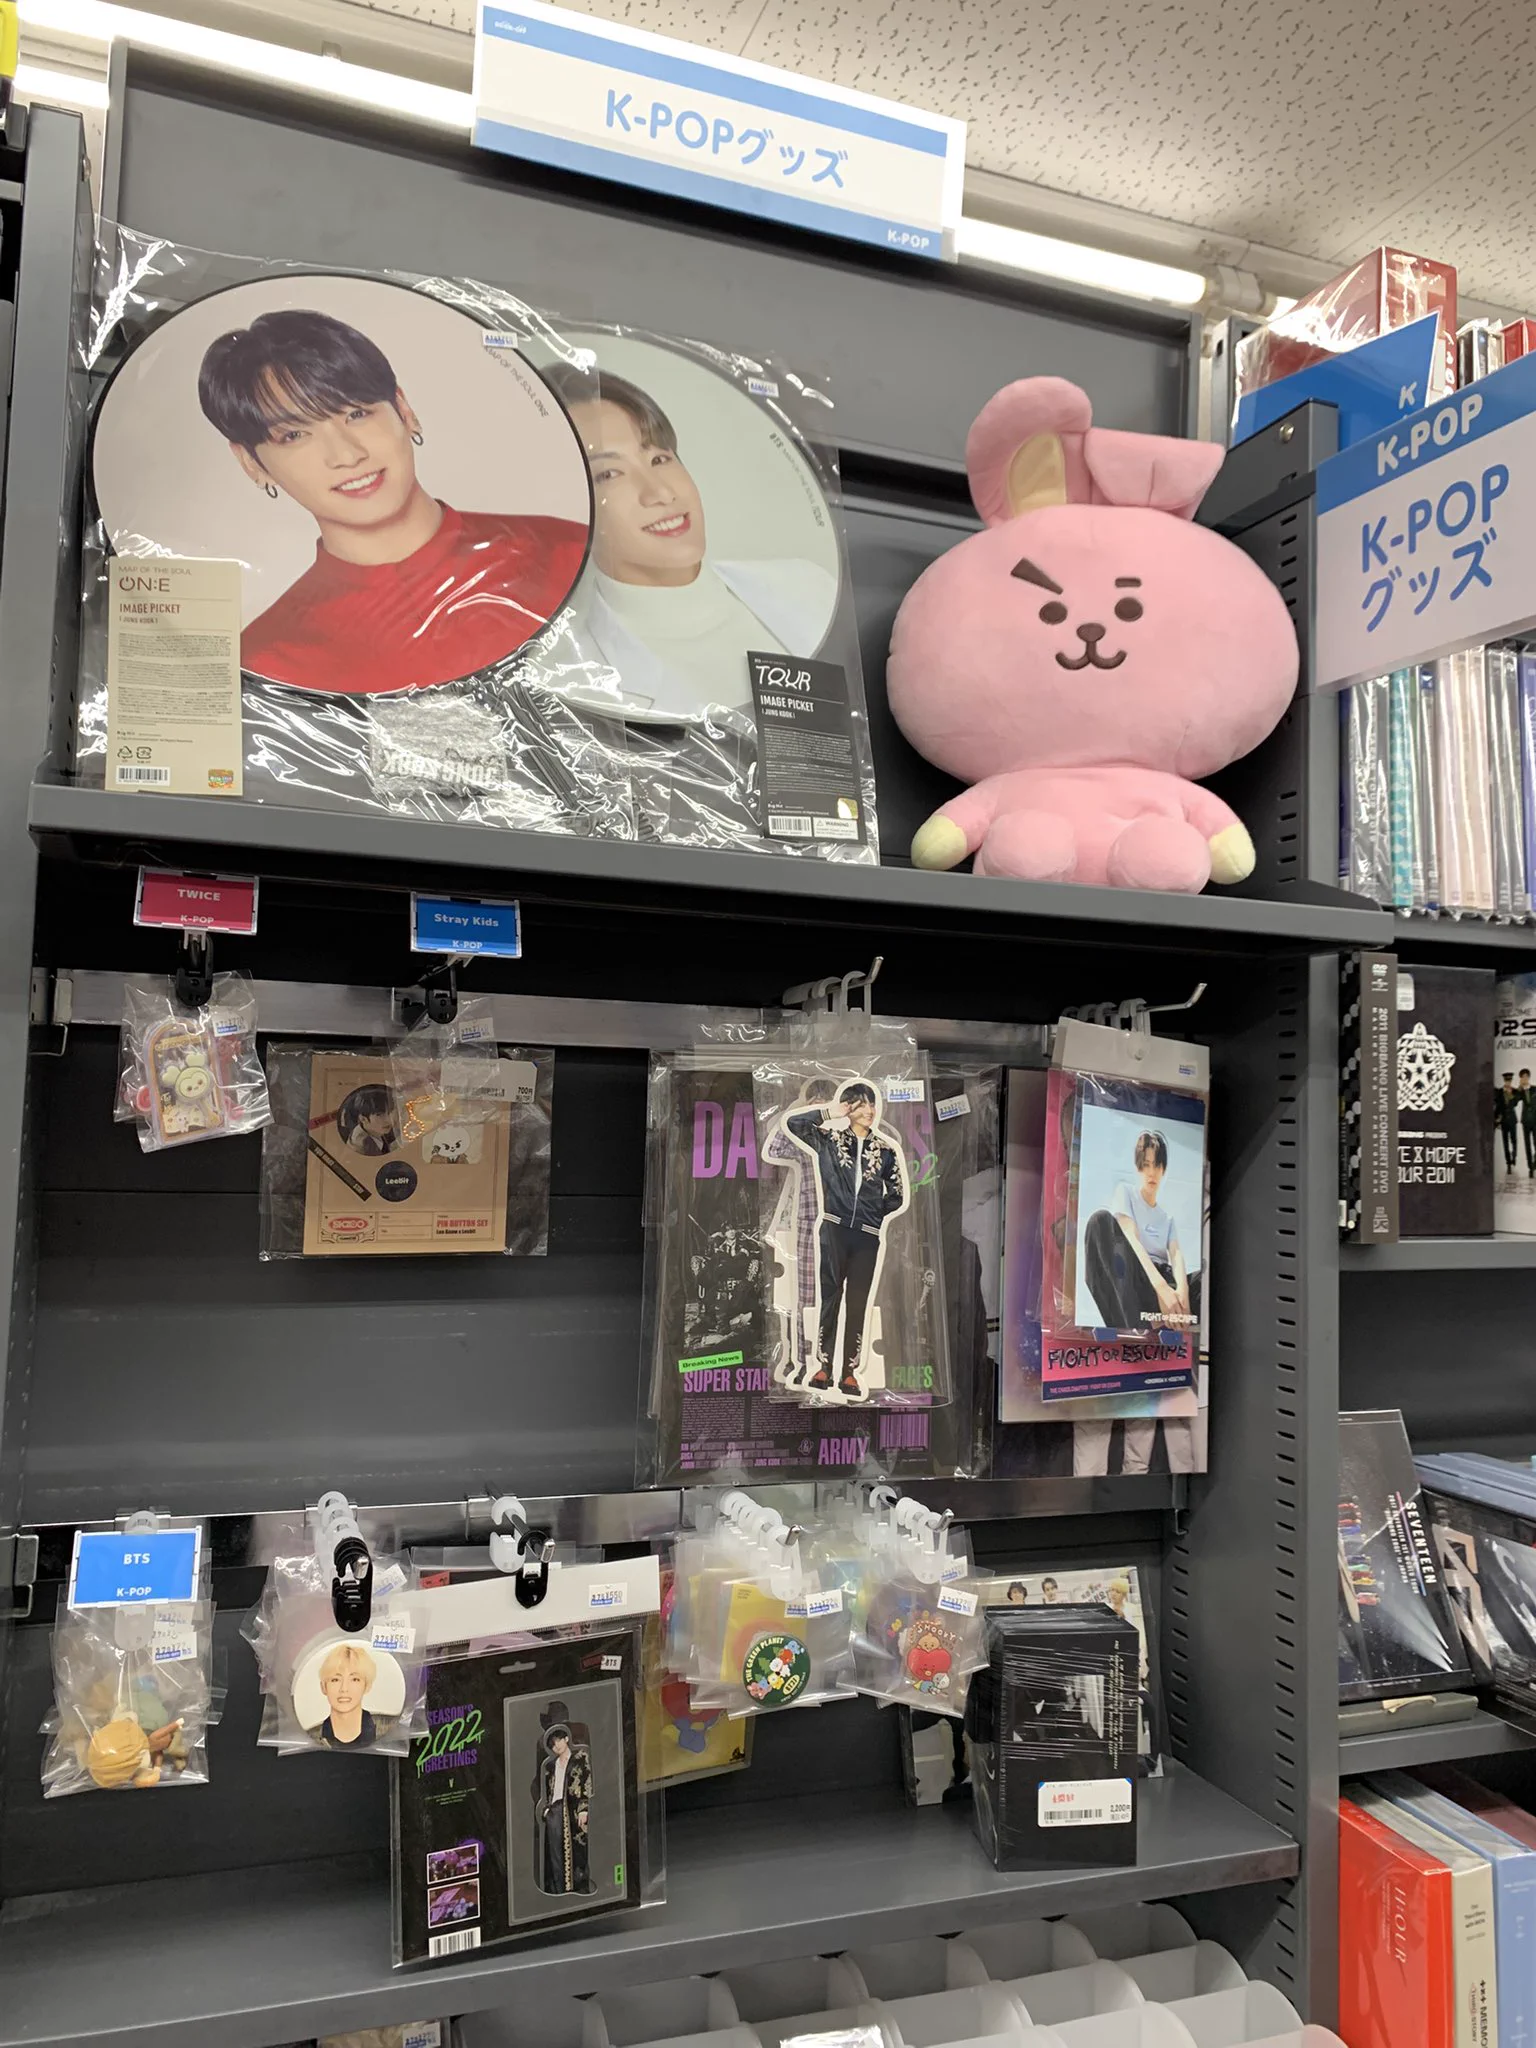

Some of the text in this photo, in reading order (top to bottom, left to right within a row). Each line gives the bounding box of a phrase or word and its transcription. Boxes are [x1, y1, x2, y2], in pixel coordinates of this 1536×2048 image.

[604, 89, 849, 189] K-POPグッズ
[887, 229, 930, 250] K-POP
[1377, 393, 1483, 477] K-POP
[1361, 463, 1509, 574] K-POP
[1361, 526, 1498, 633] グッズ
[120, 603, 180, 614] IMAGE PICKET
[755, 665, 811, 692] TOUR
[760, 694, 814, 712] IMAGE PICKET
[177, 888, 221, 902] TWICE
[180, 915, 215, 925] K-POP
[434, 913, 499, 929] Stray Kids
[452, 939, 483, 950] K-POP
[1378, 1008, 1388, 1030] 2011
[1378, 1087, 1388, 1112] LIVE
[1378, 1115, 1388, 1167] CONCERT
[1425, 1146, 1467, 1164] HOPE
[1378, 1170, 1388, 1193] DVD
[1426, 1166, 1455, 1184] 2011
[437, 1219, 488, 1228] PIN BUTTON SET
[1140, 1311, 1162, 1321] FIGHT
[1169, 1313, 1198, 1324] ESCAPE
[682, 1358, 717, 1369] Breaking
[1048, 1345, 1101, 1369] FIGHT
[1121, 1342, 1187, 1363] ESCAPE
[684, 1365, 933, 1393] SUPER STAR FACES
[818, 1437, 870, 1465] ARMY
[1405, 1500, 1437, 1585] SEVENTEEN
[123, 1553, 151, 1566] BTS
[116, 1585, 152, 1598] K-POP
[746, 1646, 761, 1668] GREEN
[760, 1637, 784, 1649] PLANET
[426, 1703, 474, 1725] SEASON'S
[415, 1709, 486, 1779] 2022
[424, 1748, 478, 1773] GREETINGS
[1480, 2006, 1488, 2048] MEMO
